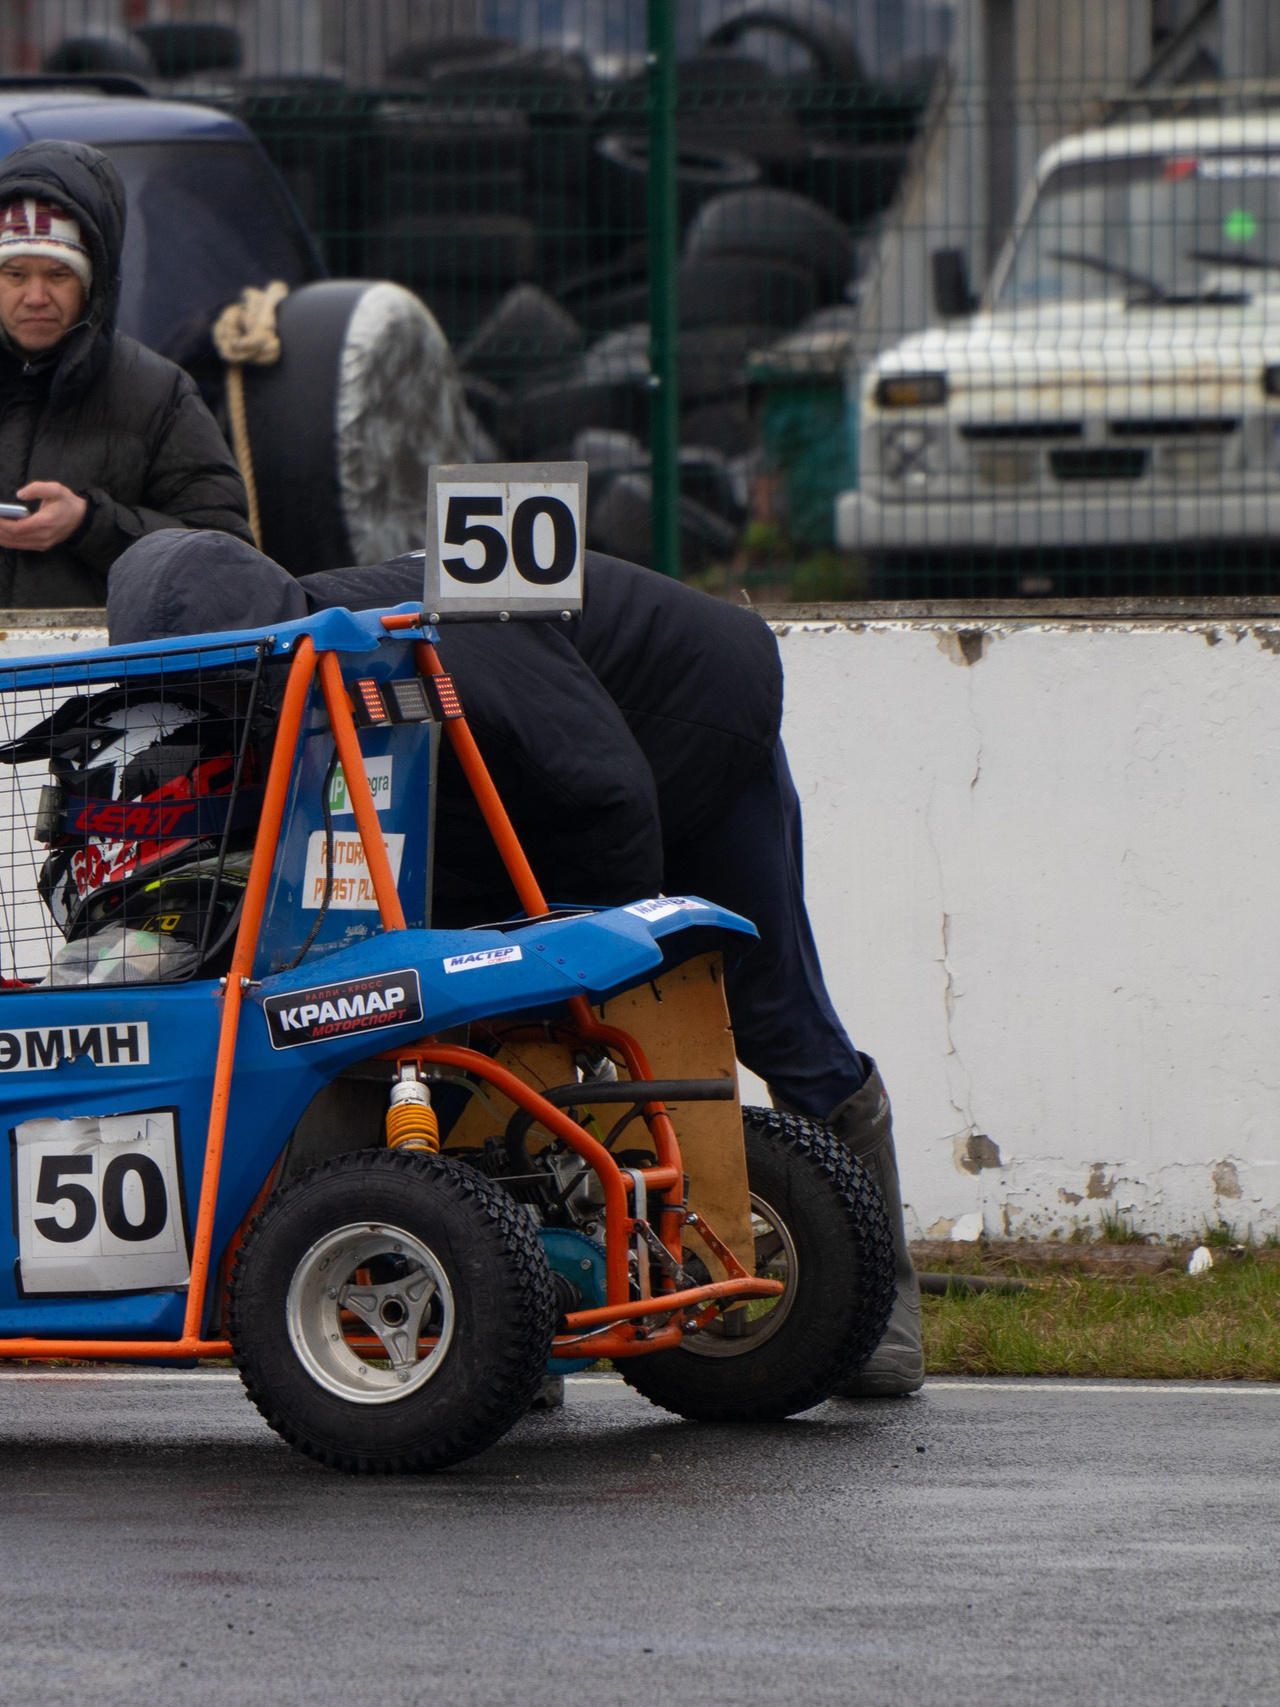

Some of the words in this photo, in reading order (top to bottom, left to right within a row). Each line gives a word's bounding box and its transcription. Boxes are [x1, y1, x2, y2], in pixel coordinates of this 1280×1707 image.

[442, 496, 577, 584] 50
[450, 947, 514, 967] МАСТЕР
[279, 987, 405, 1031] КРАМАР
[311, 1008, 407, 1037] МОТОРСПОРТ
[34, 1153, 168, 1243] 50
